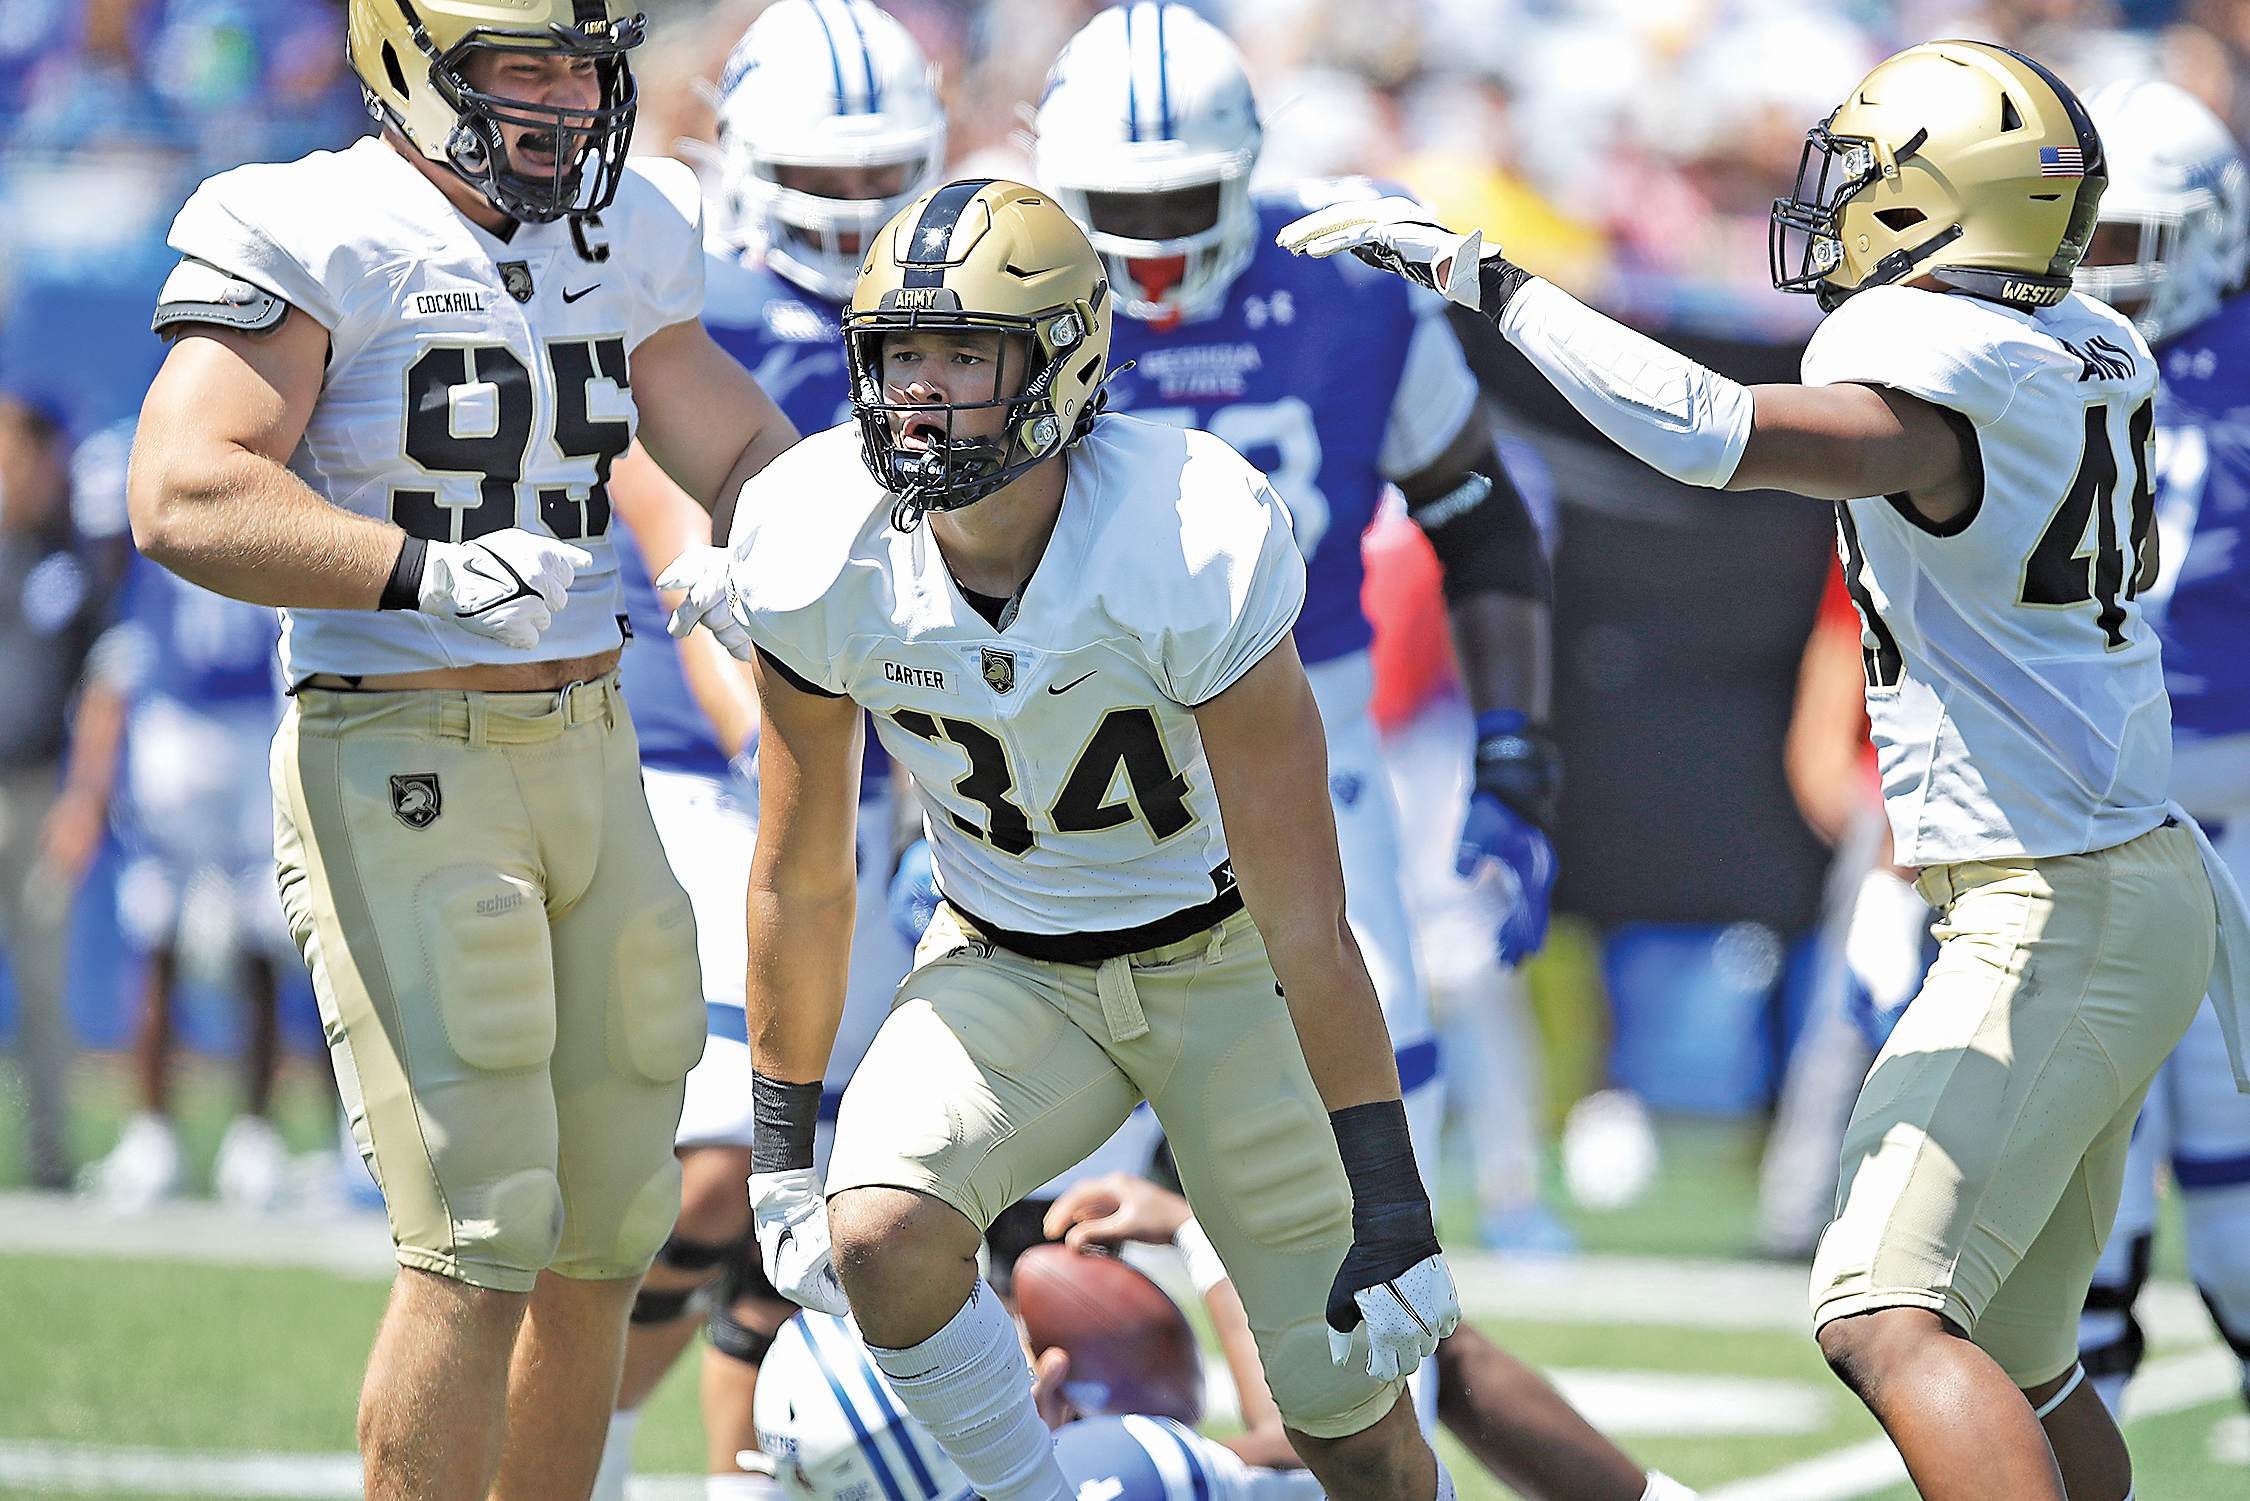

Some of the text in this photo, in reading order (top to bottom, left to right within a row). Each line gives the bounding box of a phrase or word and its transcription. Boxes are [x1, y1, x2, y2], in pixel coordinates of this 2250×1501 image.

[569, 211, 610, 264] C
[416, 292, 485, 315] COCKRILL
[894, 290, 936, 309] ARMY
[388, 331, 631, 544] 95
[884, 661, 946, 691] CARTER
[885, 704, 1201, 862] 34
